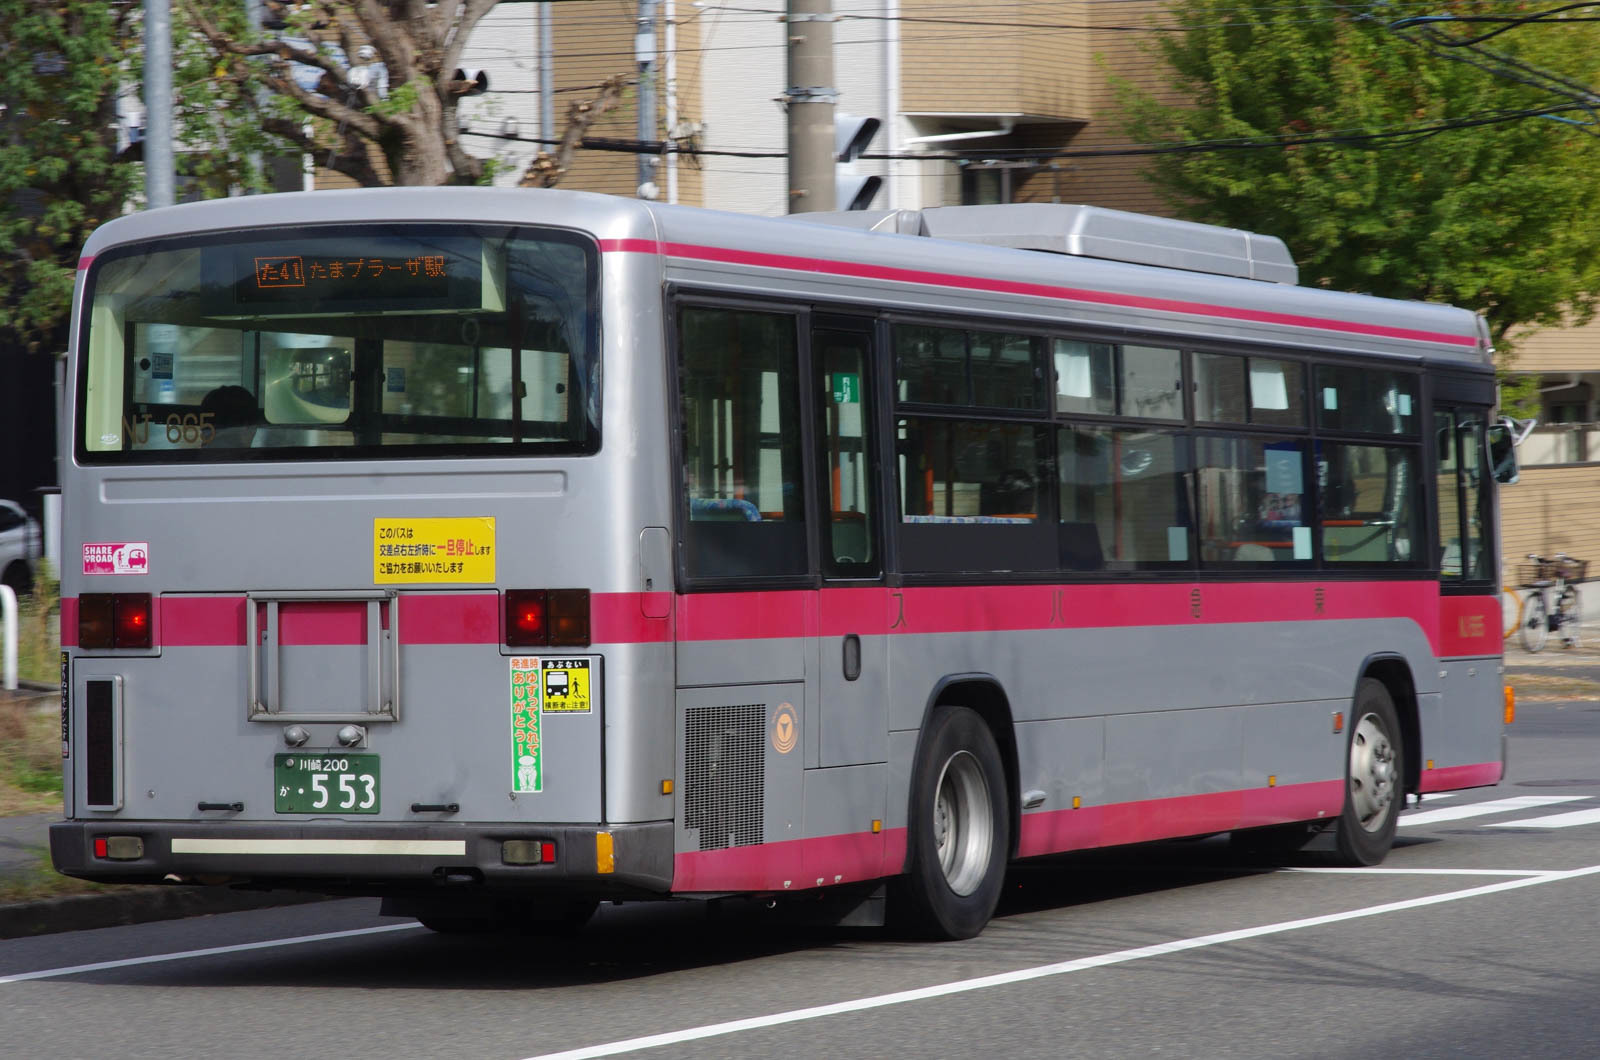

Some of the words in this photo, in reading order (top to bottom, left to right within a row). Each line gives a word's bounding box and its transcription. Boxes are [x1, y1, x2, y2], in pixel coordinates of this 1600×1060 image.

[121, 413, 153, 446] NJ
[166, 412, 216, 445] 665
[379, 527, 414, 540] このバスは
[85, 546, 113, 555] SHARE
[90, 554, 113, 563] ROAD
[379, 561, 464, 575] ご協力をお願いいたします
[547, 660, 583, 669] あぶない
[279, 785, 291, 797] か
